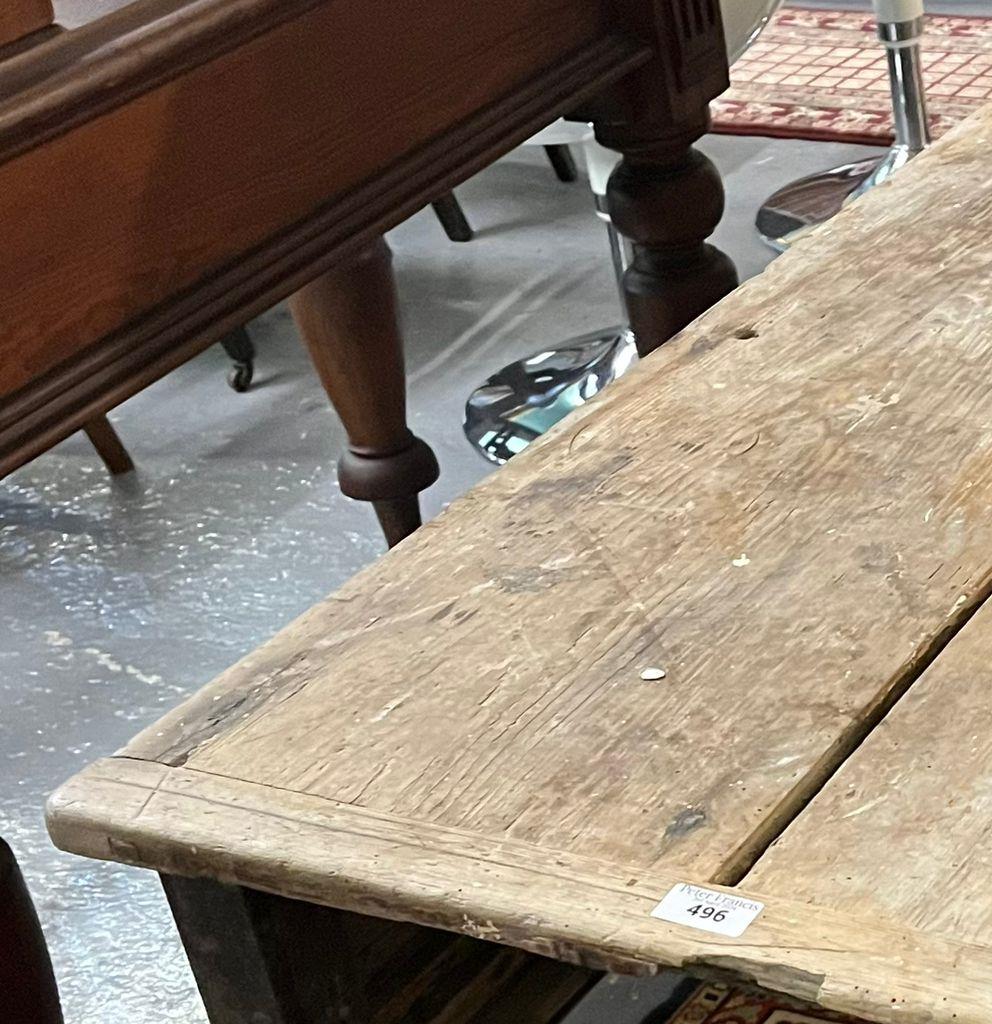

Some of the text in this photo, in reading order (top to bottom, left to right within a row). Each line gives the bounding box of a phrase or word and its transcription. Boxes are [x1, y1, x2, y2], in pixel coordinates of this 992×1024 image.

[680, 884, 713, 899] Peter
[715, 892, 759, 911] Francis
[687, 904, 729, 922] 496
